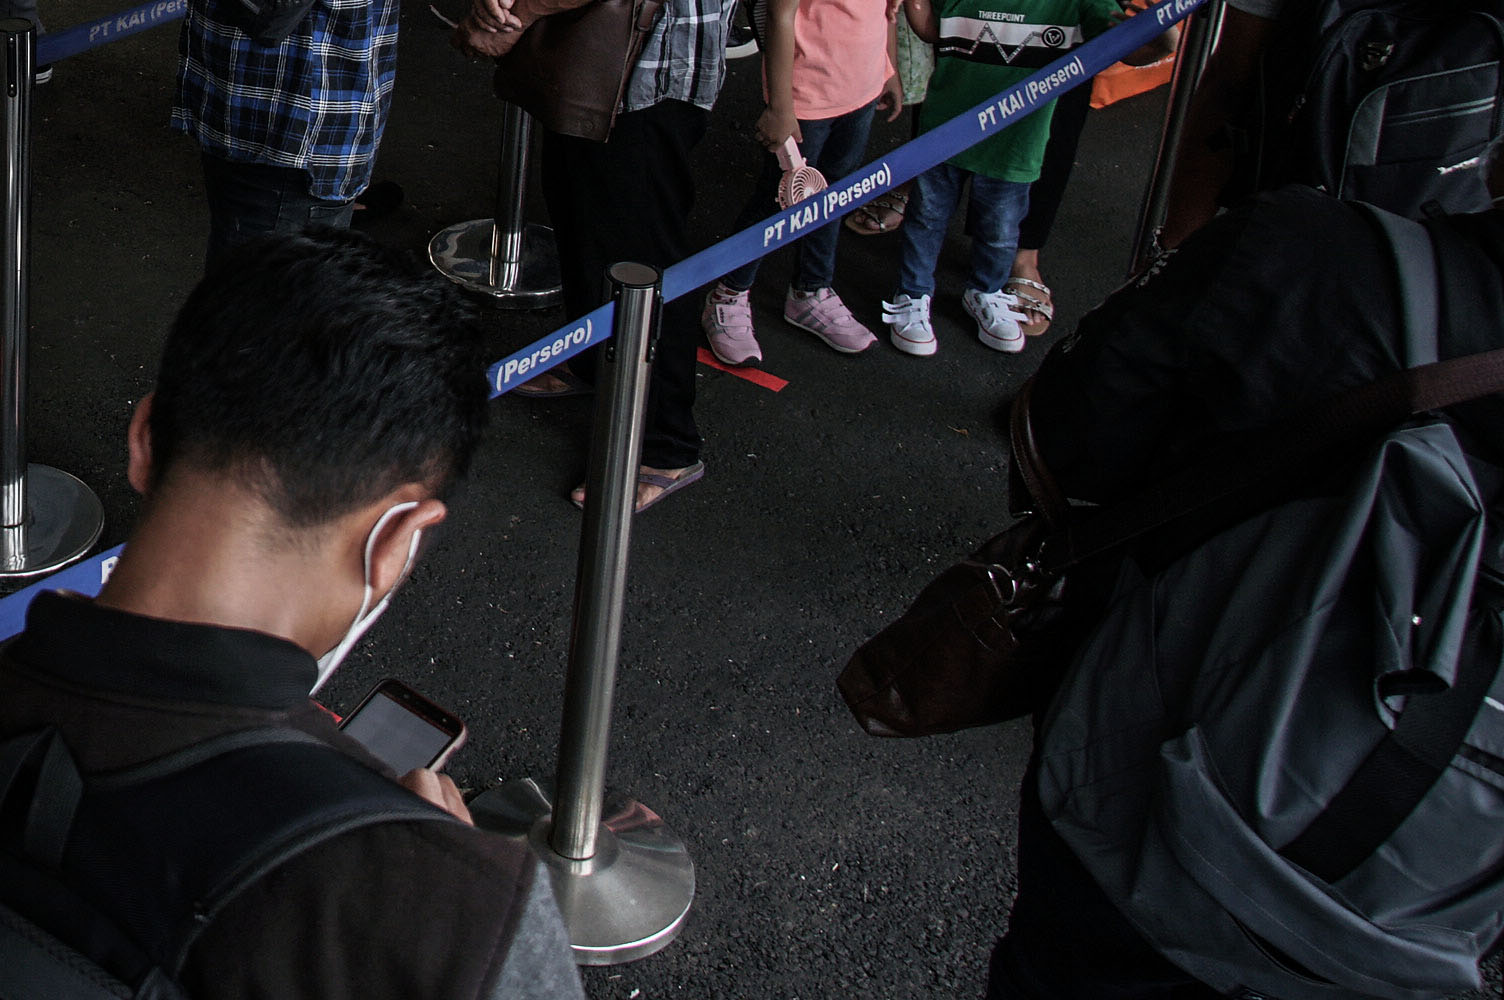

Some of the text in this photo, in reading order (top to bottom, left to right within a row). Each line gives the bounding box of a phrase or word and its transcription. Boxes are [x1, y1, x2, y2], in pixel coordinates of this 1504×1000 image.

[88, 20, 112, 42] PT
[116, 9, 146, 33] KAI
[978, 10, 1026, 23] THREEPOINT
[1155, 6, 1172, 25] PT
[977, 55, 1086, 131] PT KAI (Persero)
[763, 162, 891, 248] PT KAI (Persero)
[496, 318, 592, 392] (Persero)
[100, 556, 121, 584] P
